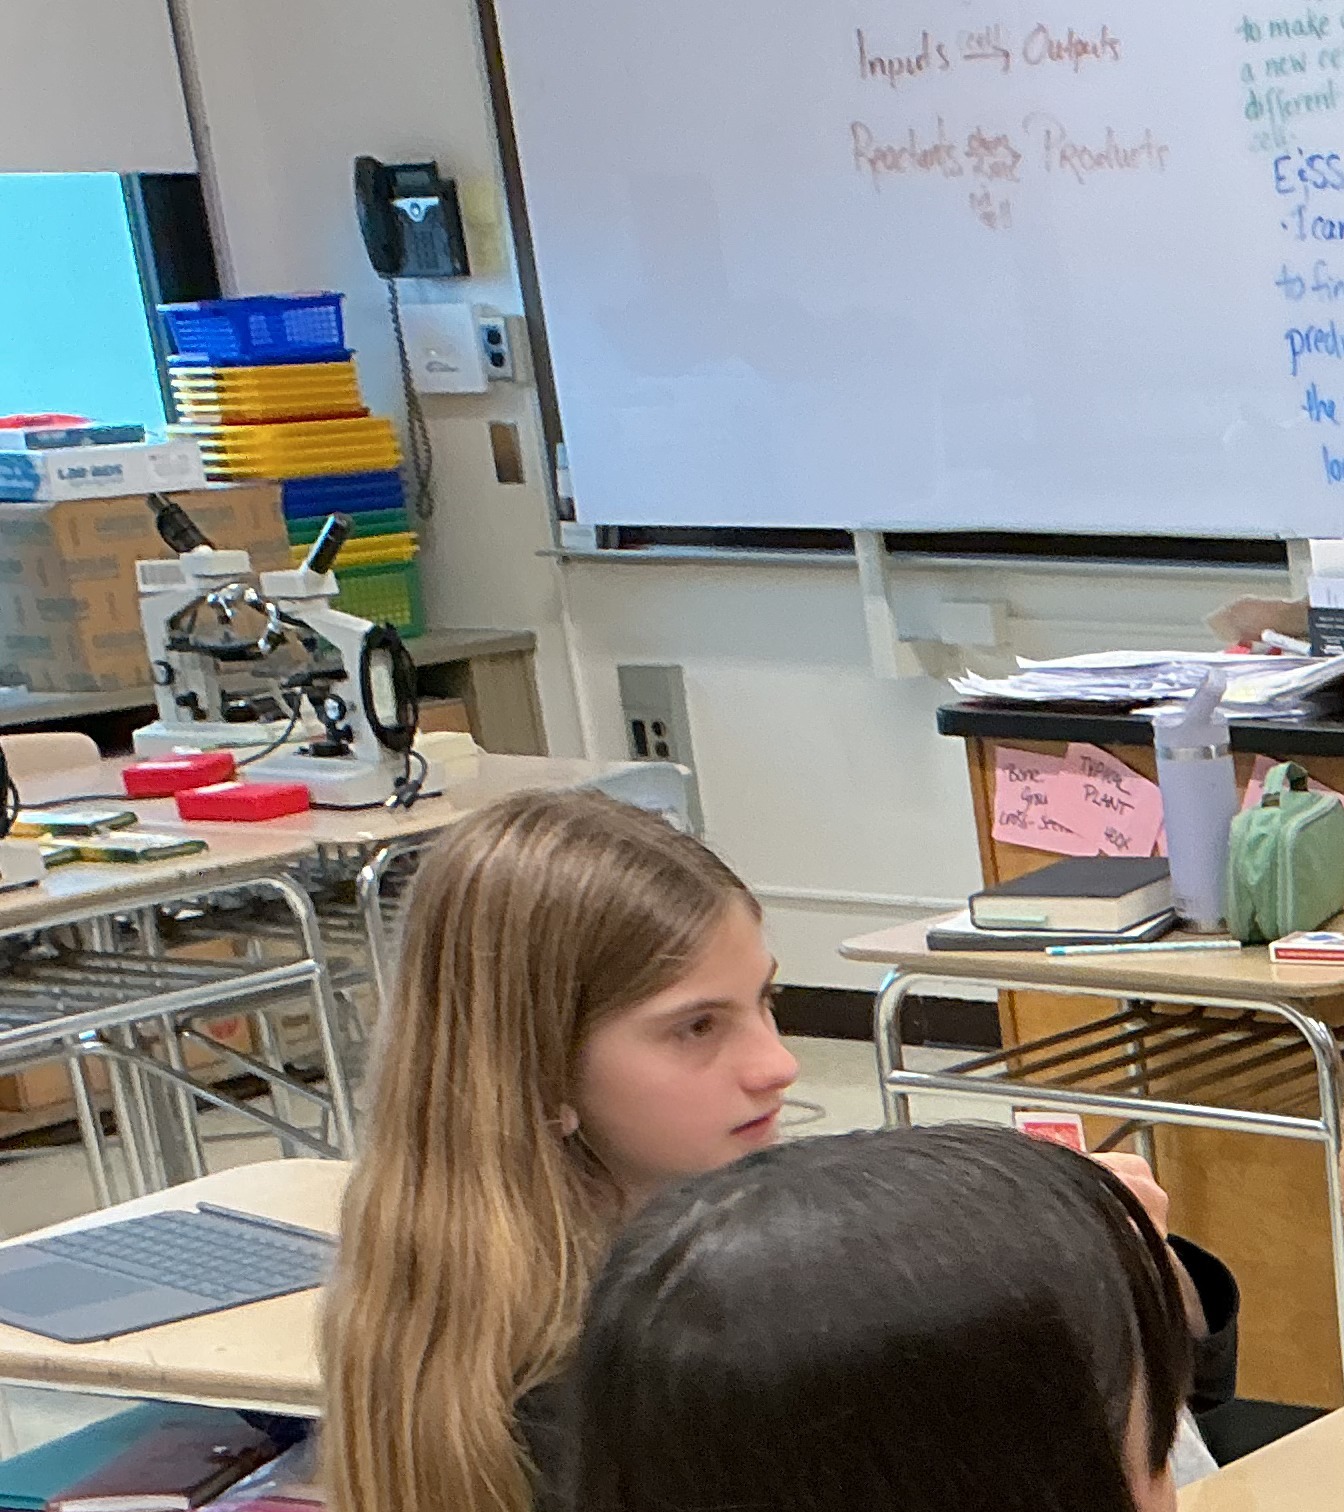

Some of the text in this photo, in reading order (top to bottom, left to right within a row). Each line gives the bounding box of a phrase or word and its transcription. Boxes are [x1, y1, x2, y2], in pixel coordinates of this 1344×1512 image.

[1269, 7, 1330, 40] make
[1265, 51, 1307, 77] new
[1302, 382, 1335, 426] the
